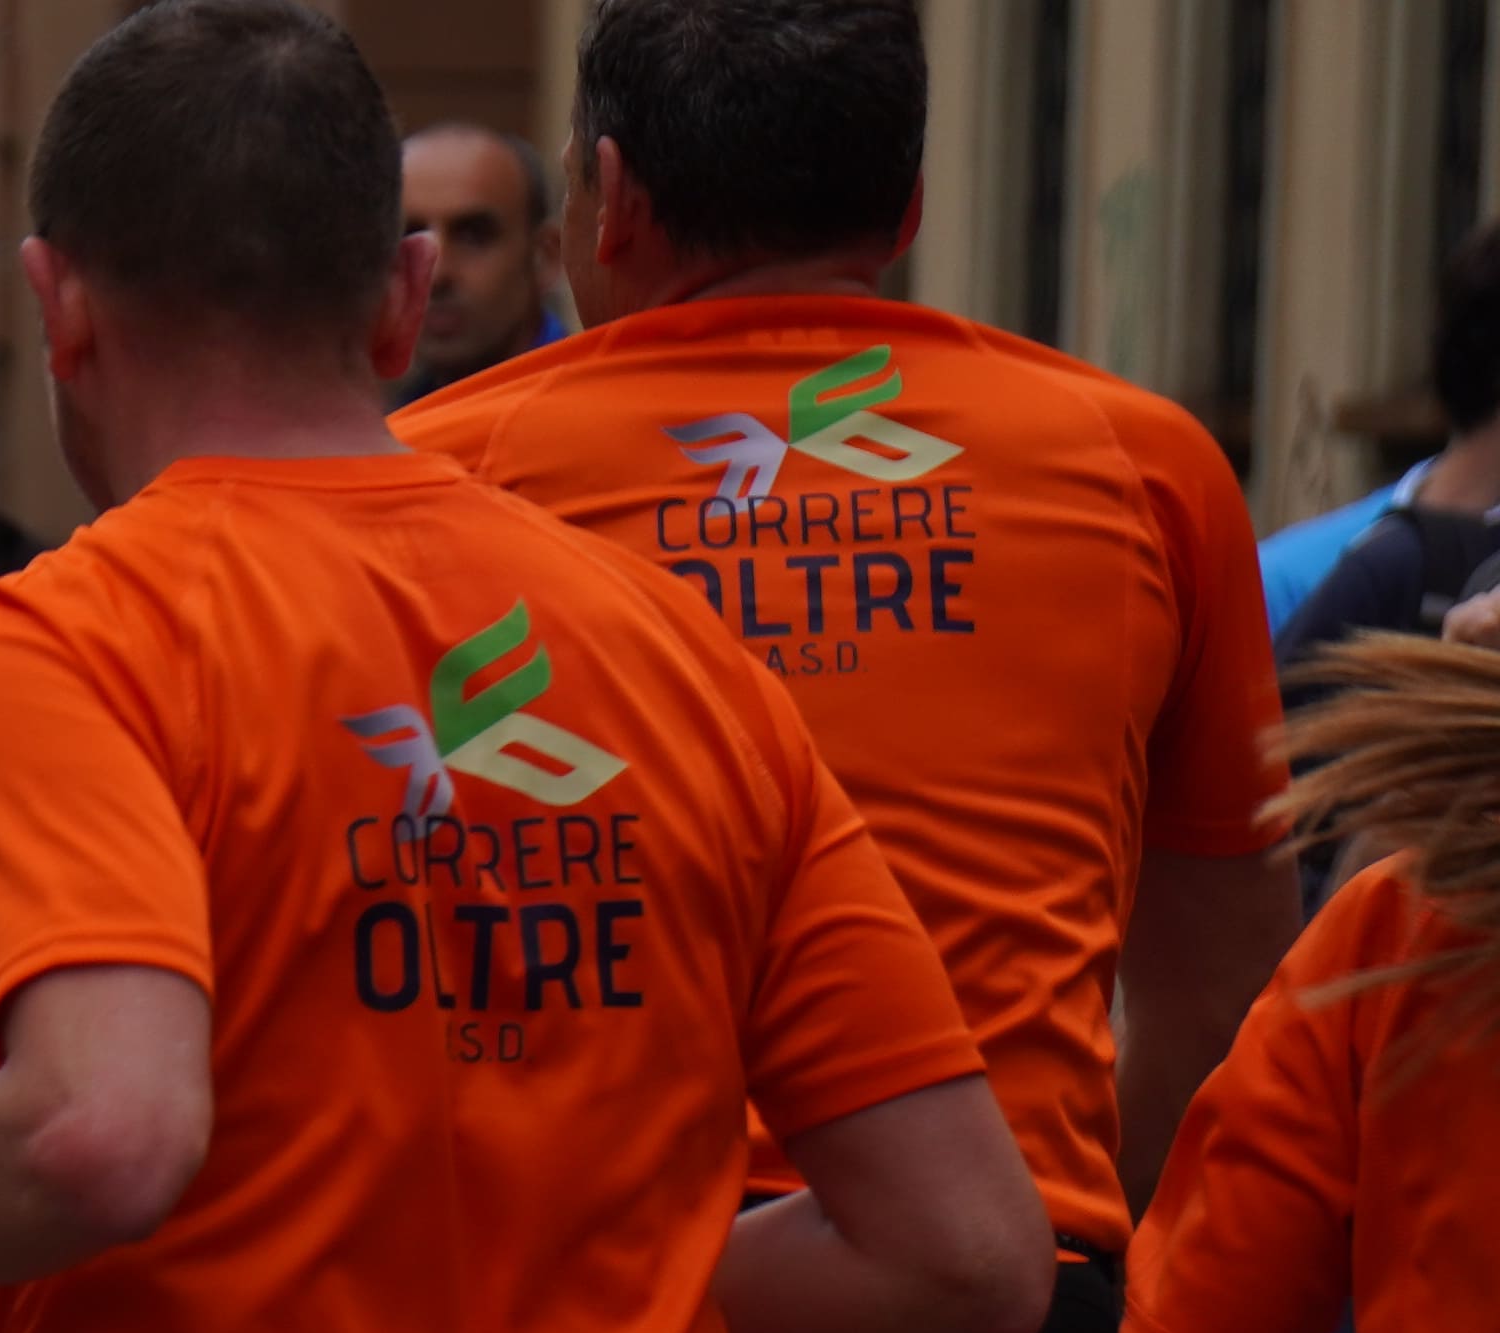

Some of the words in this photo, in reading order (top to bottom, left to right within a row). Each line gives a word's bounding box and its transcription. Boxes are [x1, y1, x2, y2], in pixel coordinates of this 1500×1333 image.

[656, 485, 977, 551] CORRERE
[346, 812, 643, 892] CORRERE
[354, 899, 644, 1014] OLTRE
